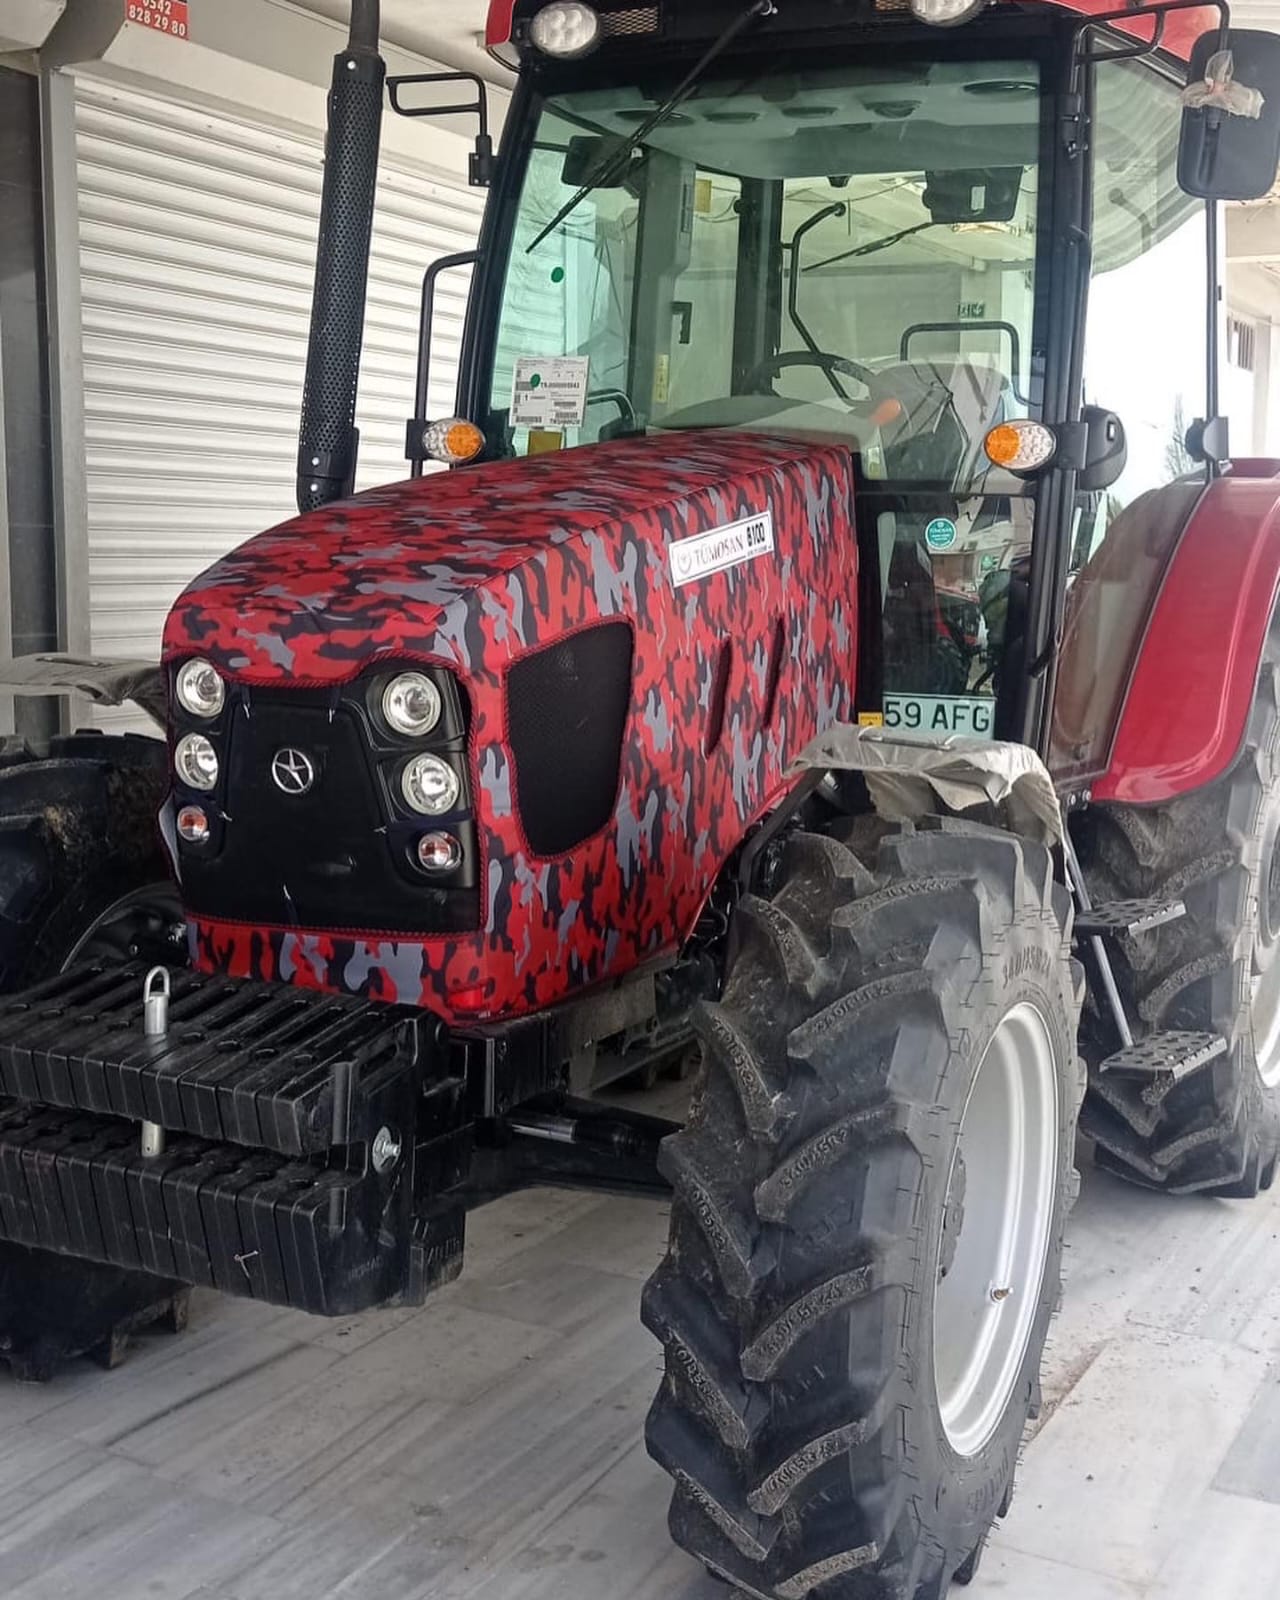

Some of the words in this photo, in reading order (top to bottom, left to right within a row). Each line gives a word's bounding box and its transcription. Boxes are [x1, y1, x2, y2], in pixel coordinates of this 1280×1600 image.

[128, 4, 151, 24] 828
[154, 14, 168, 30] 29
[171, 20, 186, 36] 80
[694, 533, 744, 566] TÜMOSAN
[885, 701, 921, 729] 59
[931, 703, 990, 733] AFG
